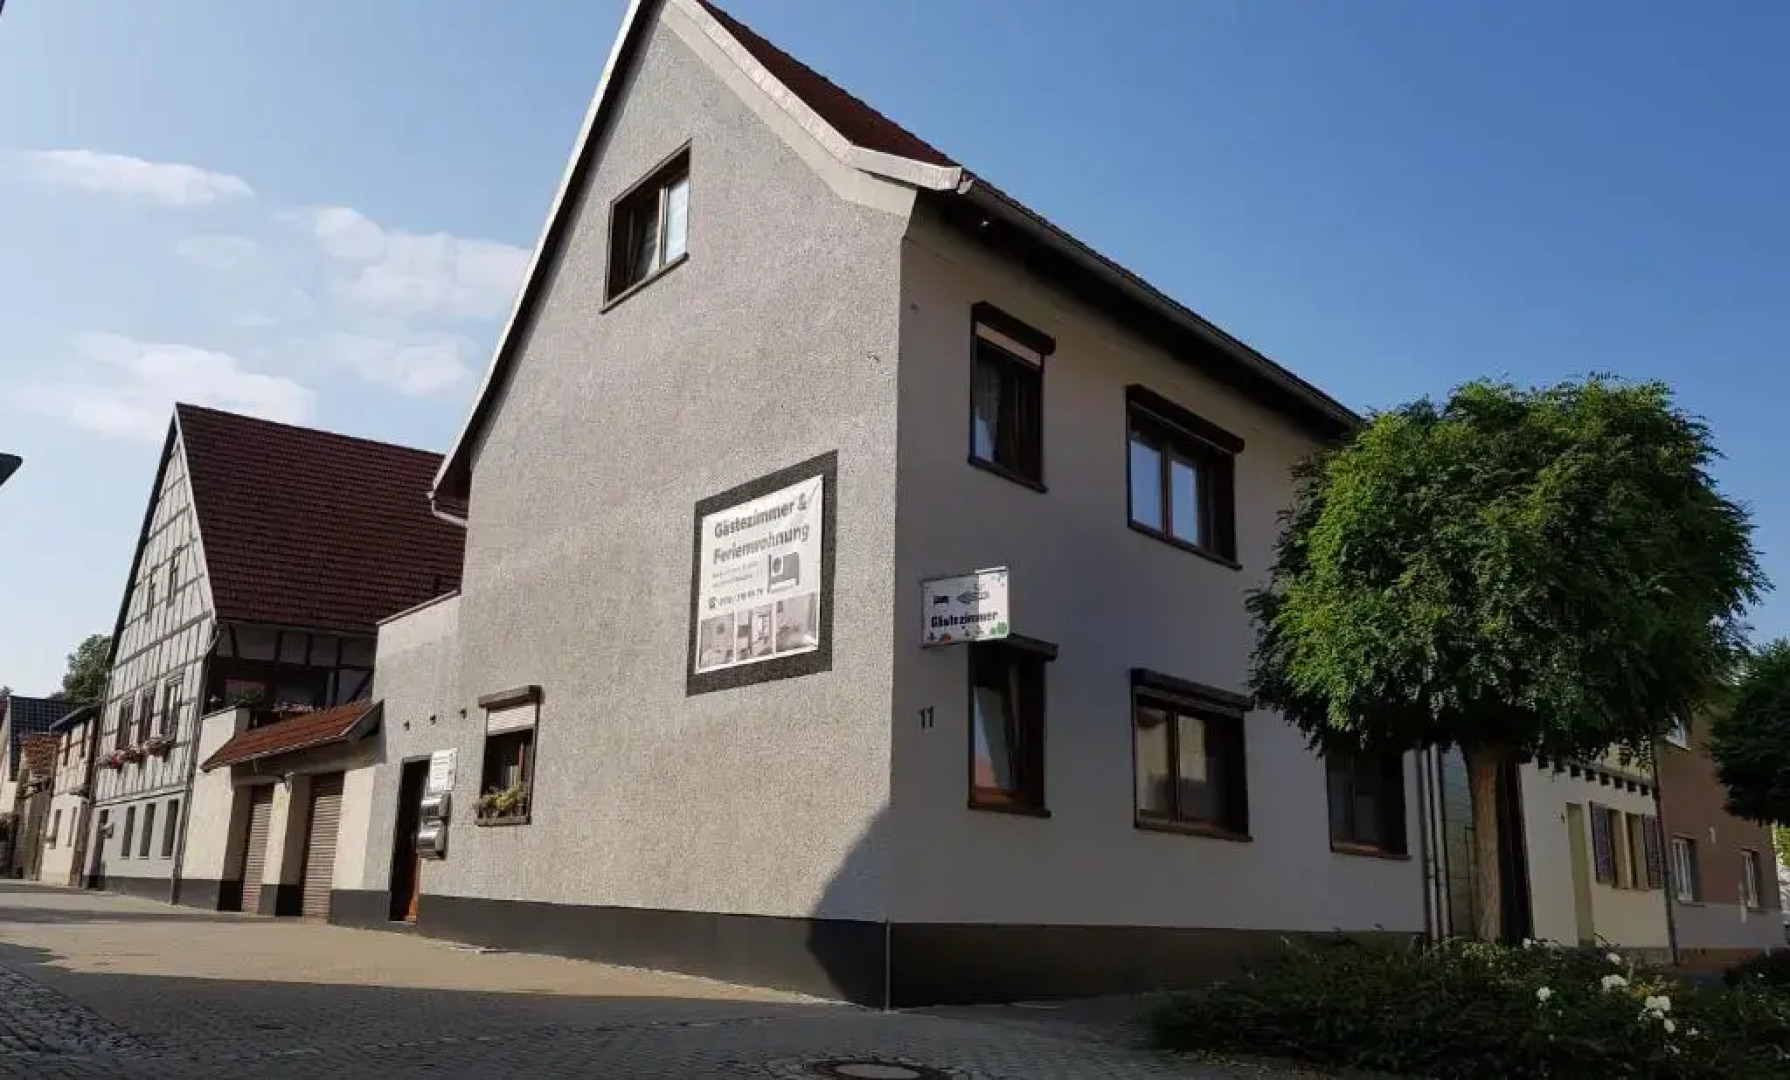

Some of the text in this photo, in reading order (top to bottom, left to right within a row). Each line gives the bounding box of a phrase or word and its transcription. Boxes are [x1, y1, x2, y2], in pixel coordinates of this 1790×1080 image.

[713, 501, 795, 539] Gästezimmer
[712, 523, 810, 565] Ferienwohnung
[930, 610, 999, 629] Gästezimmer
[918, 705, 935, 730] 11
